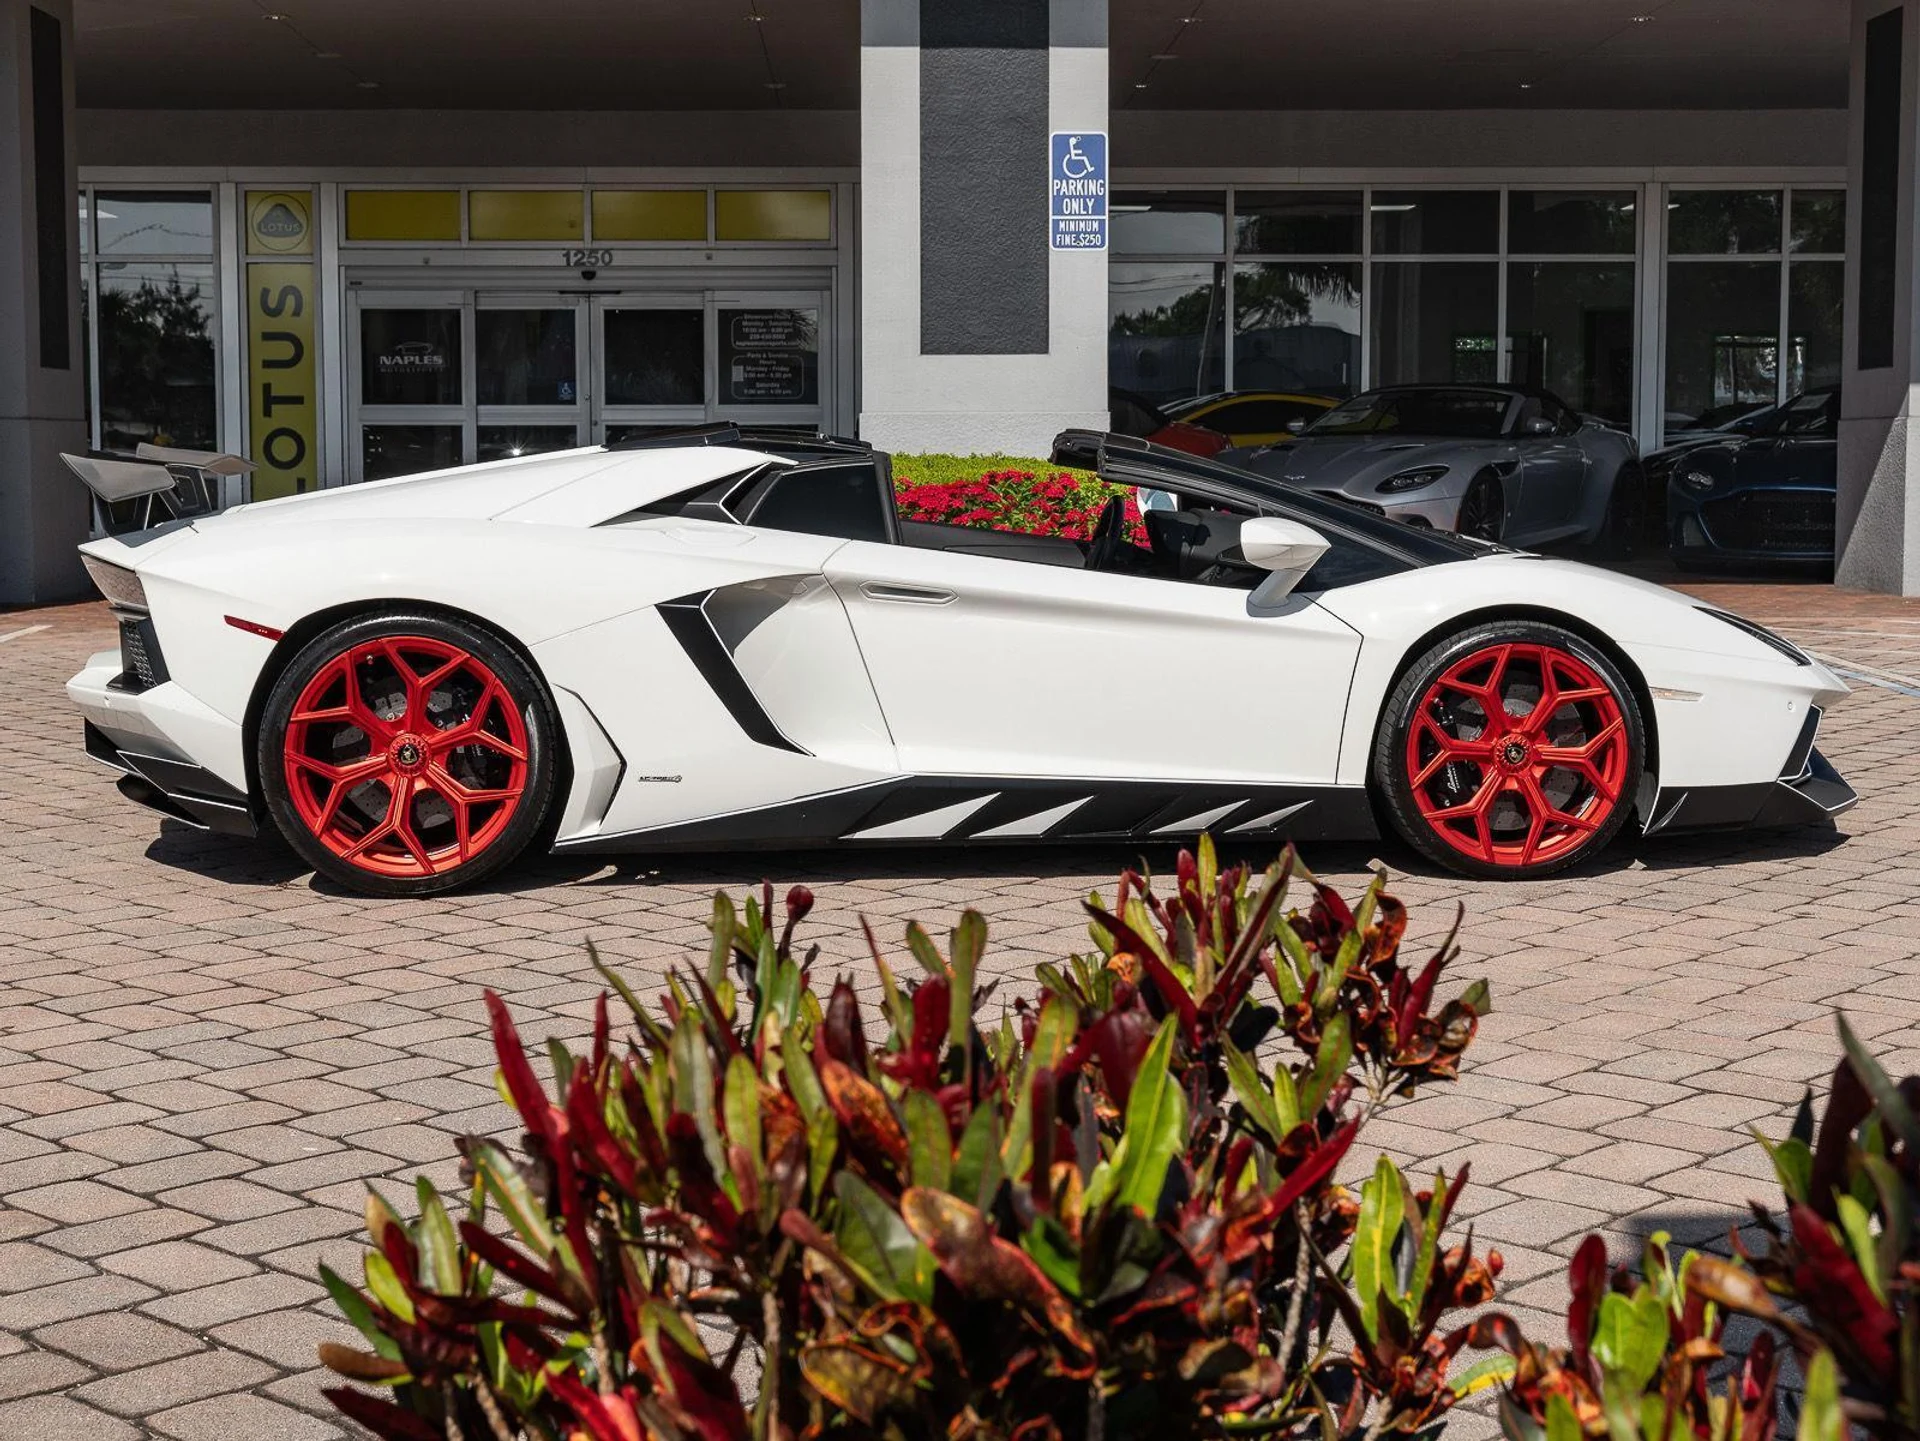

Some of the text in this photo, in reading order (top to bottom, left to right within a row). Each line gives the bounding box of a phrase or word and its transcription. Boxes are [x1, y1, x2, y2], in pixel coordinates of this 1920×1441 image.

[1053, 180, 1105, 196] PARKING
[1063, 198, 1095, 214] ONLY
[260, 223, 301, 233] LOTUS
[1059, 221, 1099, 232] MINIMUM
[562, 249, 613, 267] 1250
[379, 355, 443, 365] NAPLES
[260, 284, 306, 494] OTUS
